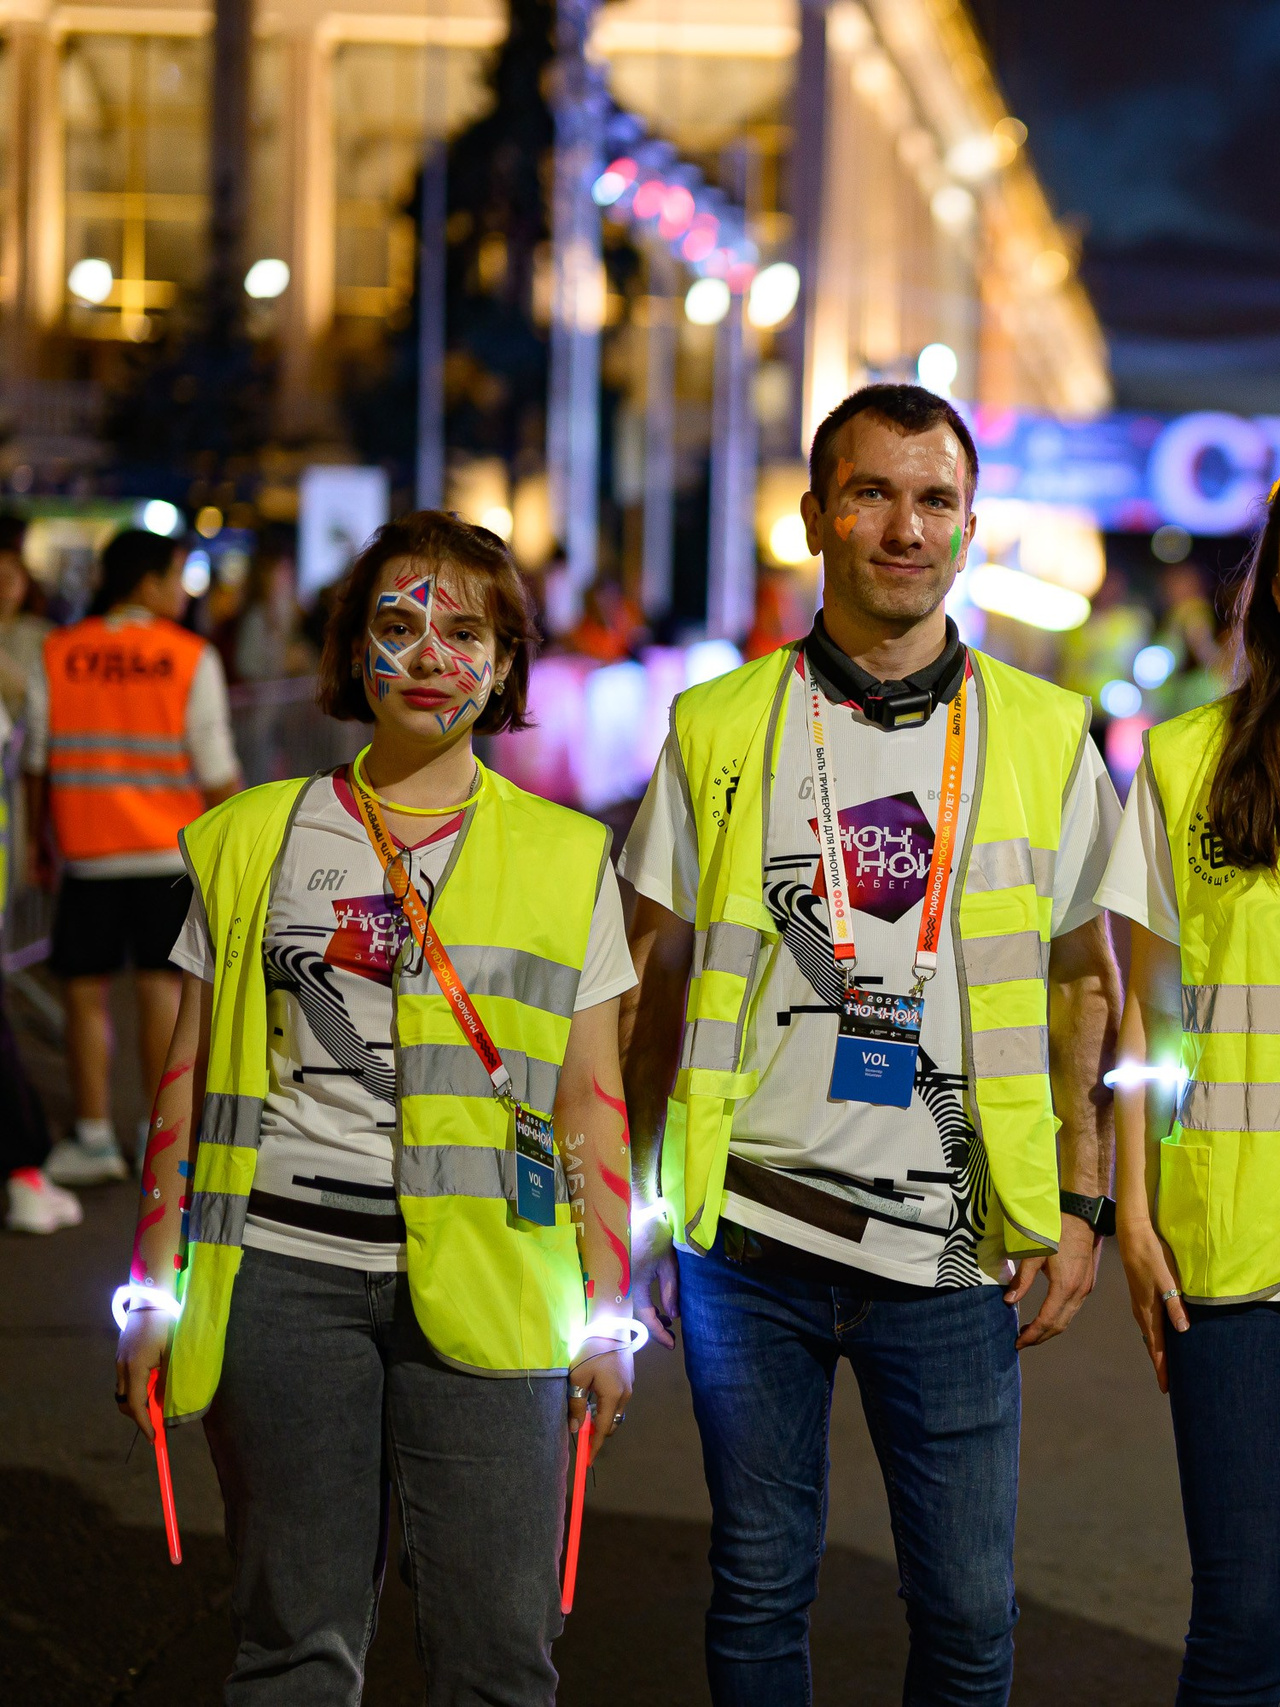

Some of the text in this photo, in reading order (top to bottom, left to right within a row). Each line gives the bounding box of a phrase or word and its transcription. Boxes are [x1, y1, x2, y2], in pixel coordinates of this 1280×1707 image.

[363, 800, 385, 842] ПРИМЕРОМ
[816, 747, 840, 888] БЫТЬ ПРИМЕРОМ ДЛЯ МНОГИХ
[929, 867, 944, 916] МАРАФОН
[938, 825, 951, 865] МОСКВА
[945, 792, 955, 809] ЛЕТ
[952, 713, 961, 736] БЫТЬ
[845, 880, 909, 889] АБЕГ
[430, 947, 455, 987] МОСКВА
[449, 986, 480, 1034] МАРАФОН
[844, 1001, 919, 1024] НОЧНОЙ
[867, 995, 900, 1005] 2024
[862, 1051, 890, 1067] VOL
[528, 1171, 543, 1188] VOL
